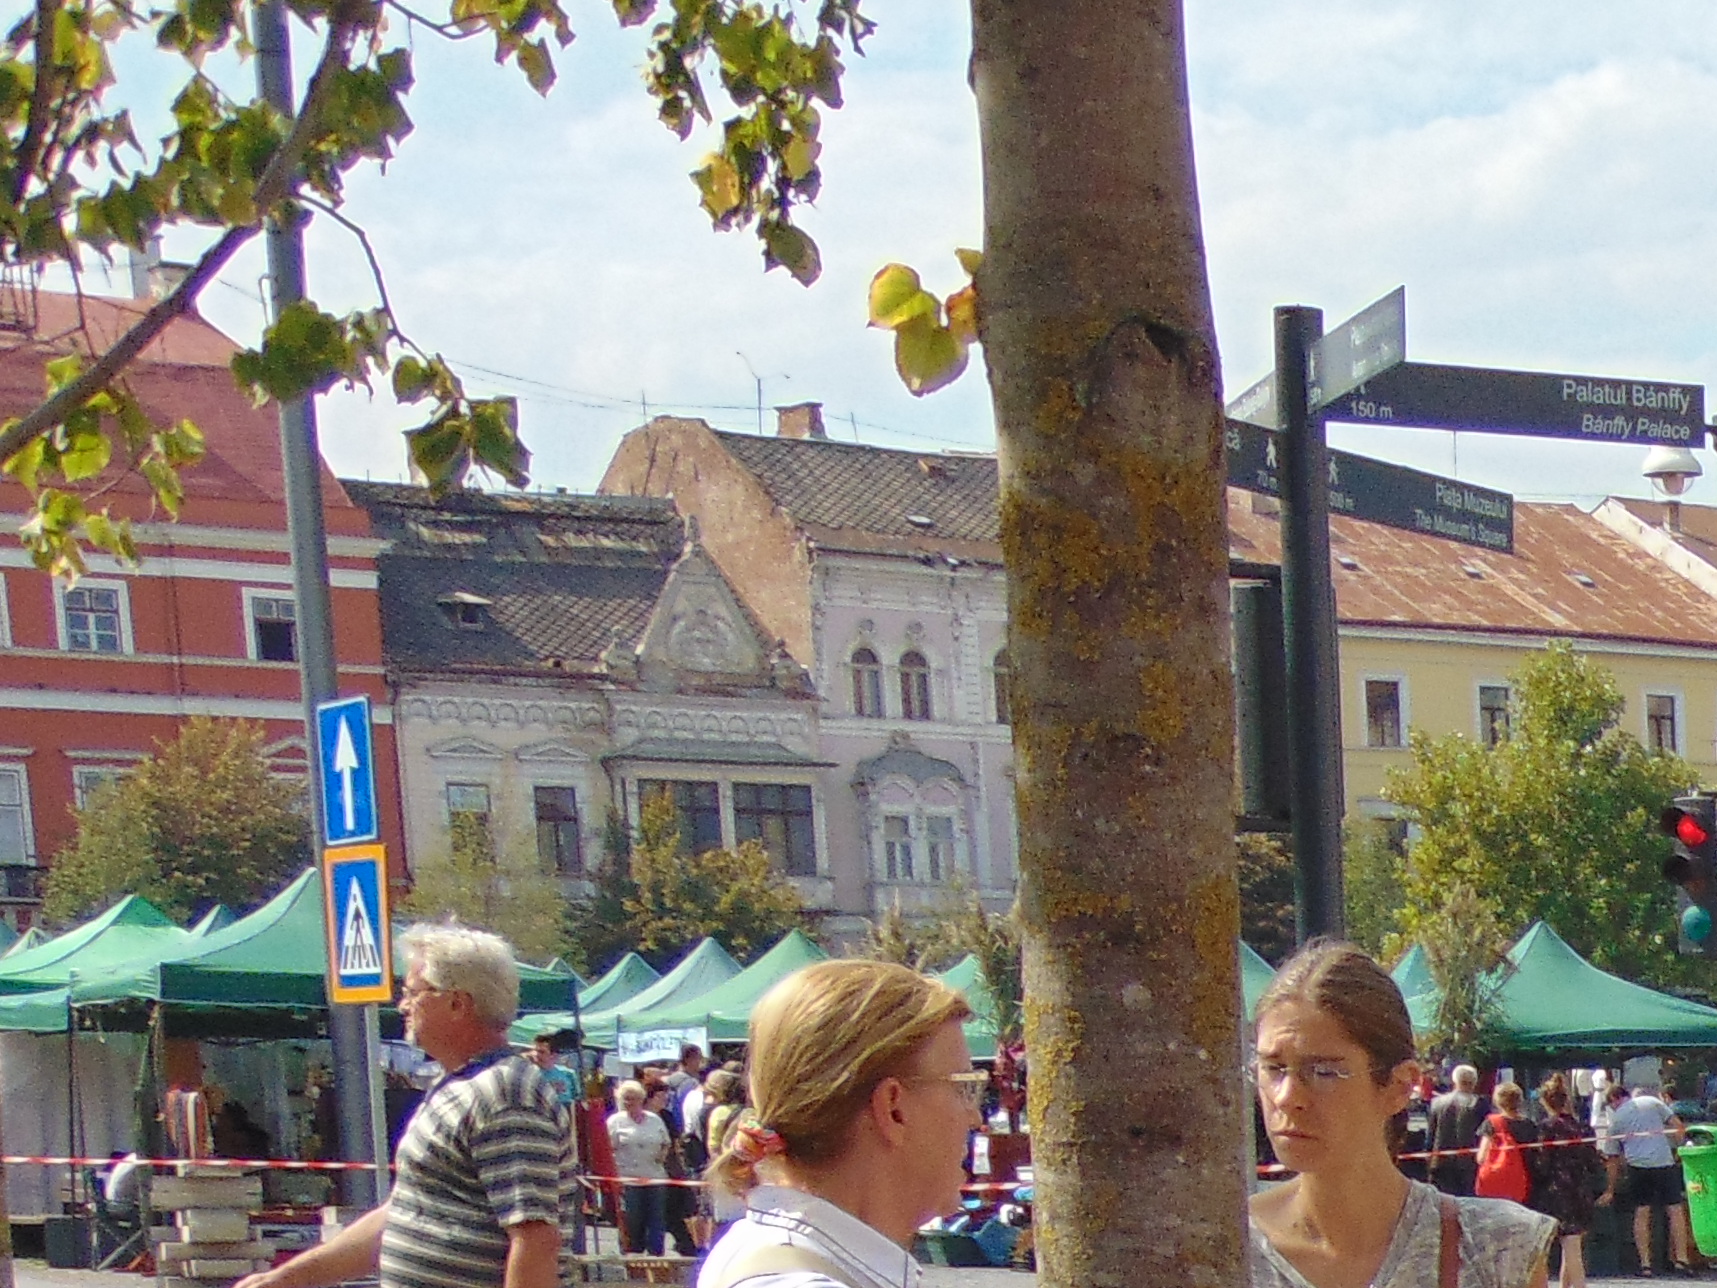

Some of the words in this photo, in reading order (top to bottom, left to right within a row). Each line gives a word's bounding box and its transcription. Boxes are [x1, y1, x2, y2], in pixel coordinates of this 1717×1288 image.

[1351, 401, 1376, 418] 150
[1380, 406, 1393, 418] m
[1562, 379, 1626, 405] Palatul
[1632, 383, 1690, 415] Bánffy
[1582, 413, 1633, 440] Bánffy
[1636, 417, 1690, 441] Palace
